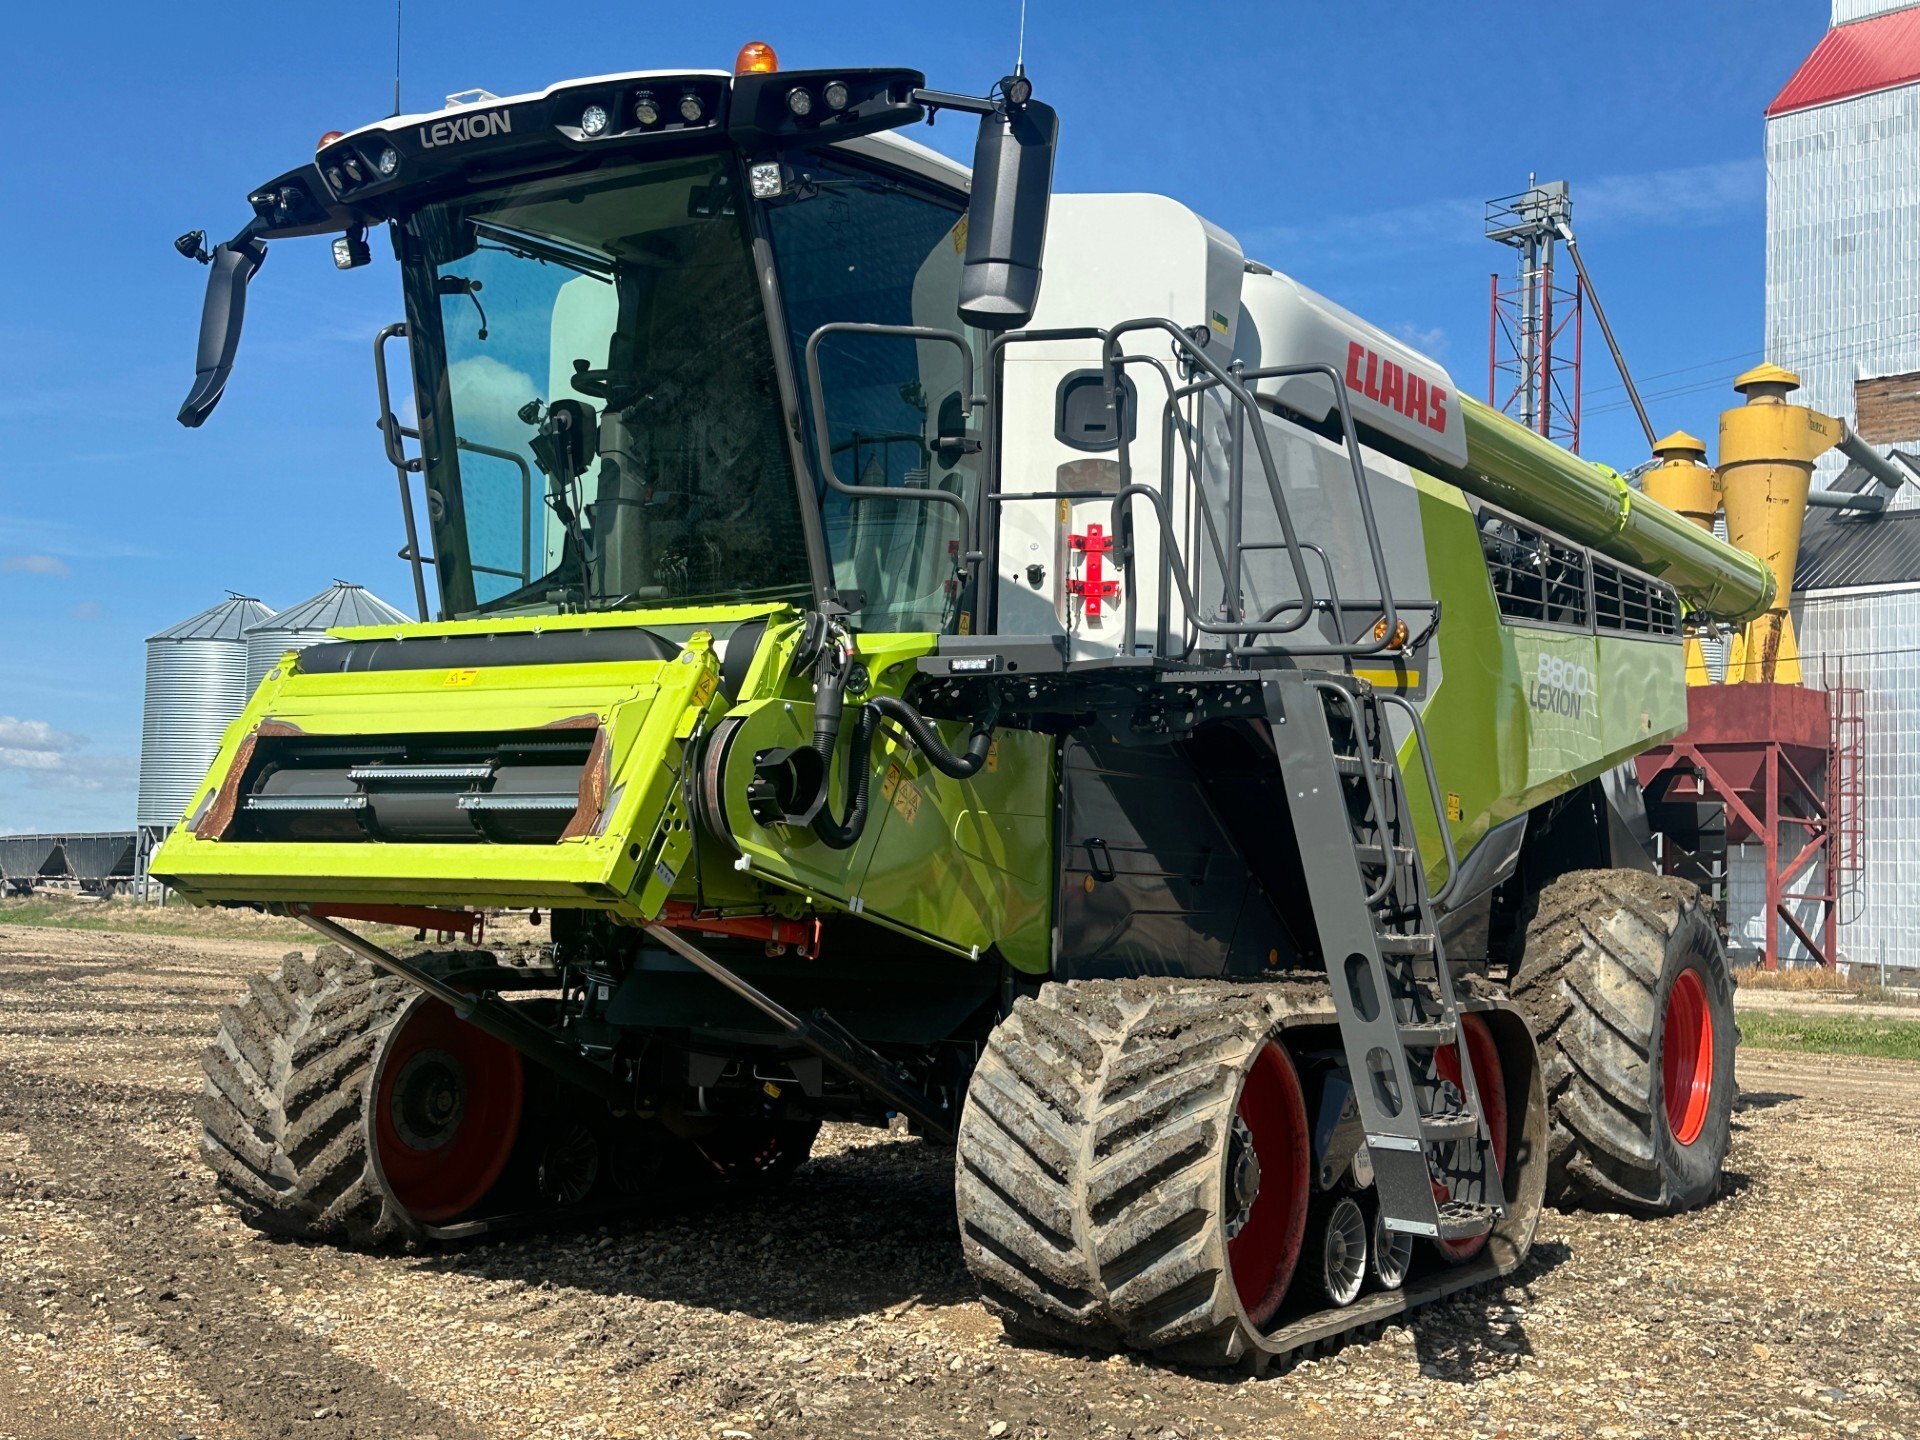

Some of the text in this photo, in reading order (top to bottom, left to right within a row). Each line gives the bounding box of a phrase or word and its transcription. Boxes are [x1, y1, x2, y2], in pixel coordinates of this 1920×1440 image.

[420, 110, 511, 149] LEXION
[1345, 341, 1447, 434] CLAAS
[1538, 652, 1588, 696] 8800
[1529, 680, 1581, 720] LEXION
